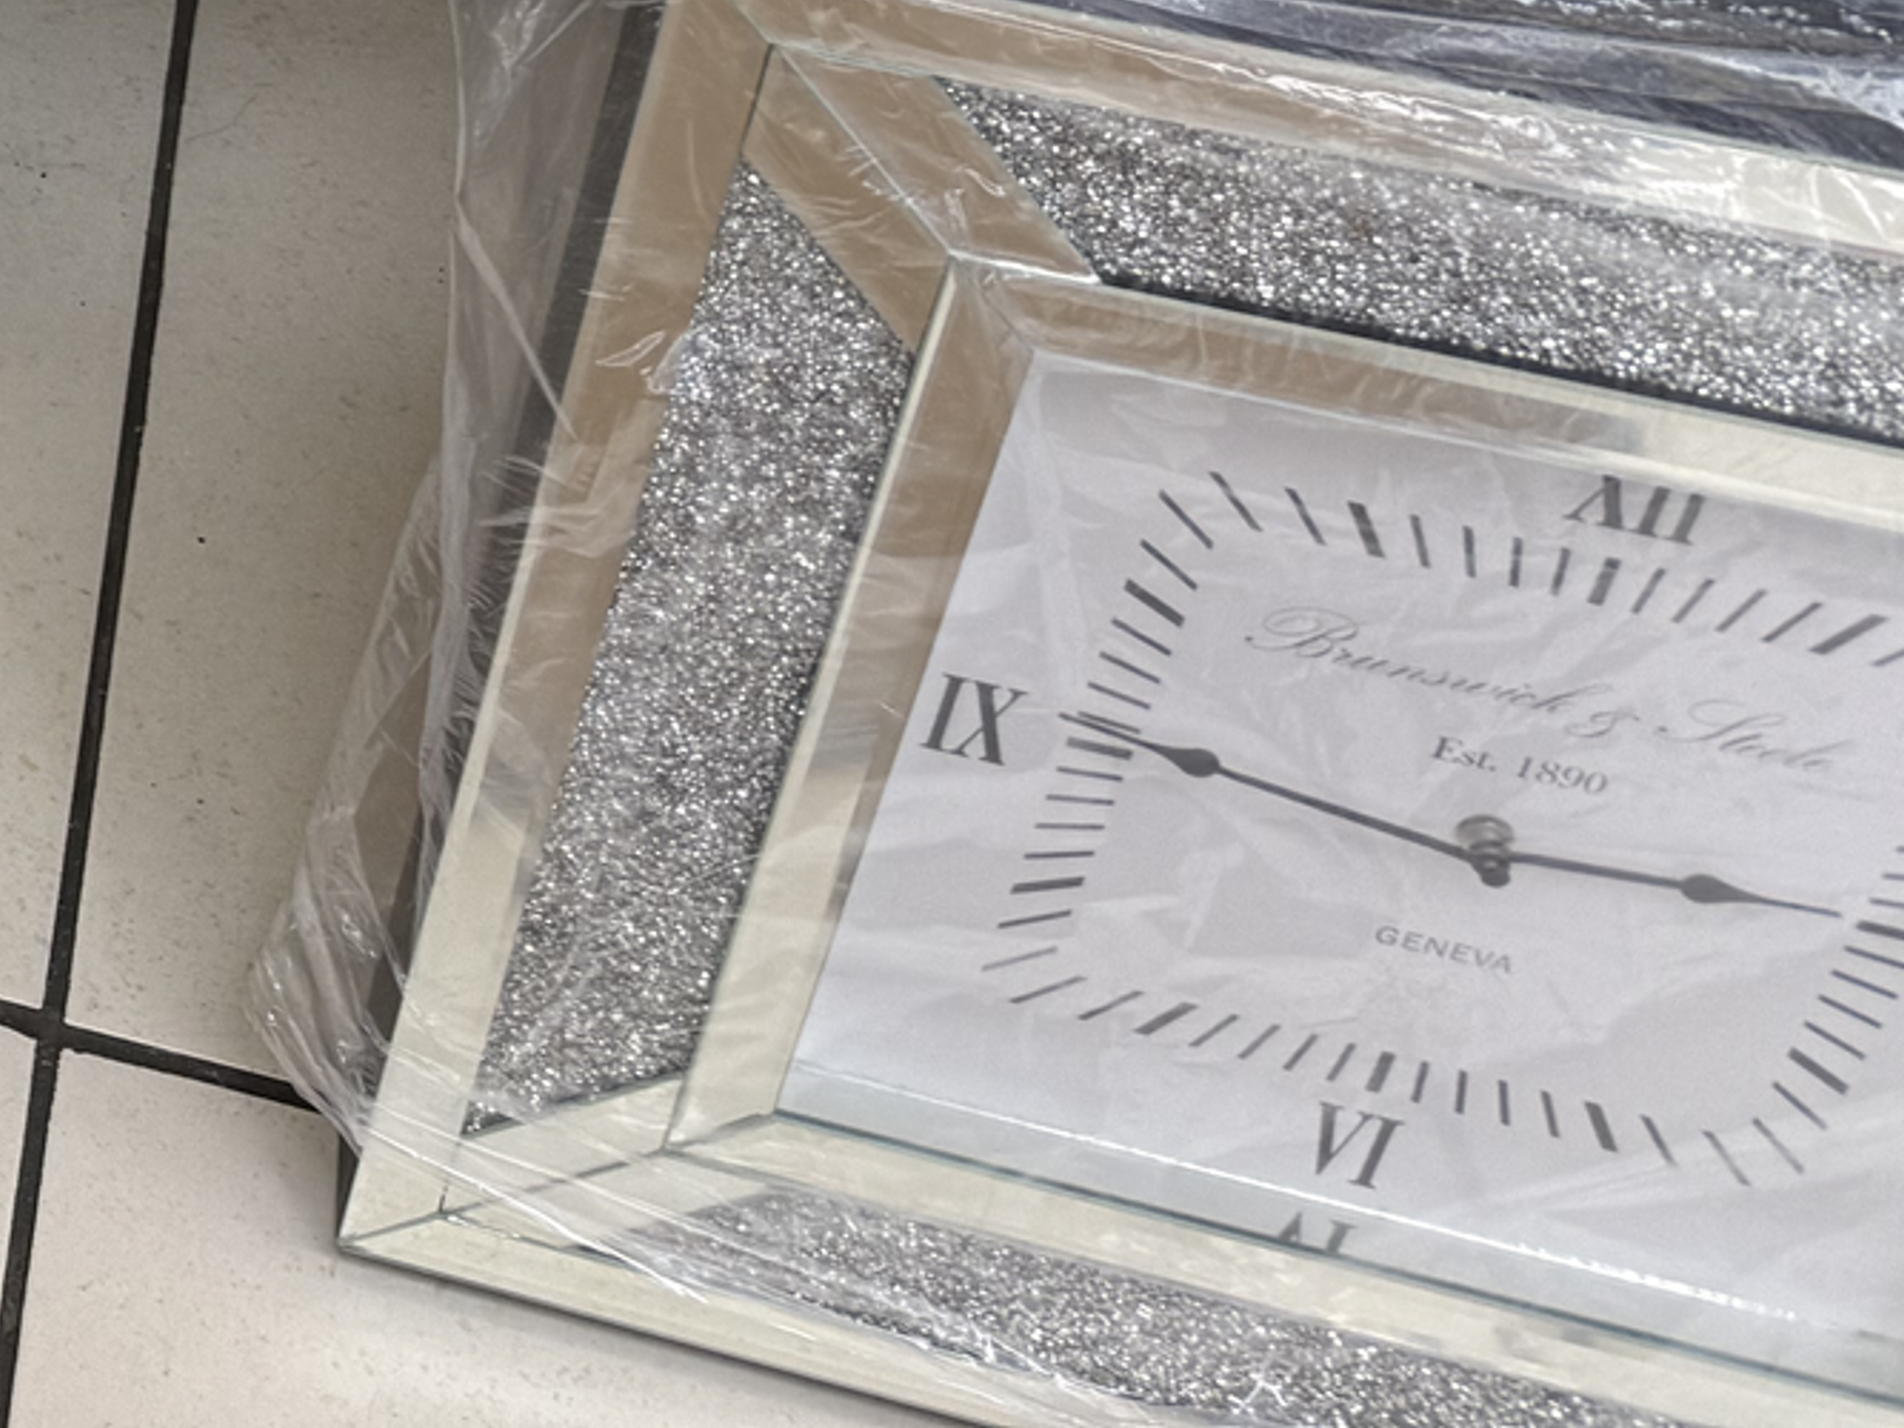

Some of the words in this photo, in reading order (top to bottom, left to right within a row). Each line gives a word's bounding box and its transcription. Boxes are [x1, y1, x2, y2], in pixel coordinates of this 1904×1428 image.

[1244, 605, 1612, 714] Brunswick
[920, 673, 1028, 767] IX
[1430, 735, 1497, 776] Est.
[1516, 756, 1609, 797] 1890
[1374, 925, 1512, 974] GENEVA
[1314, 1100, 1406, 1190] VI
